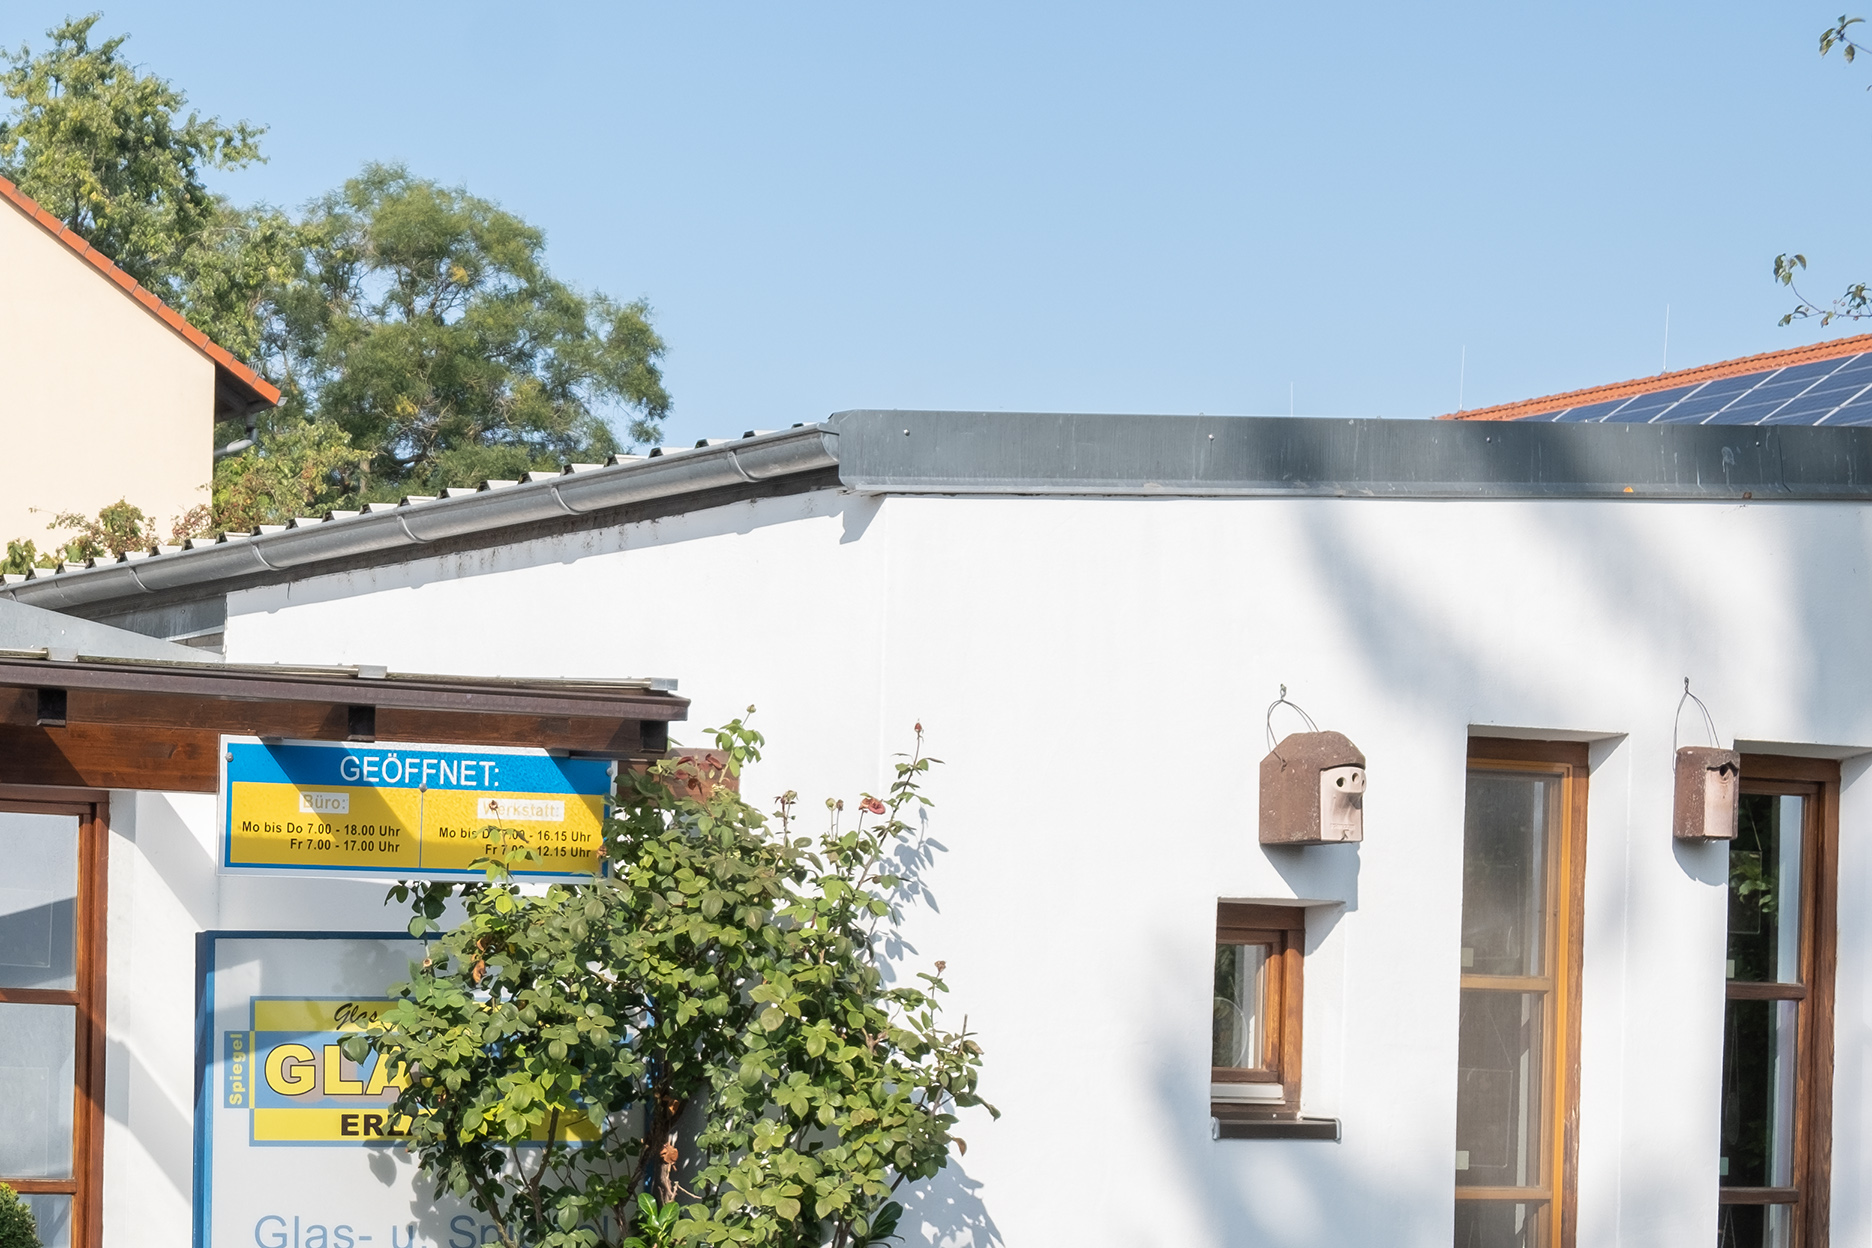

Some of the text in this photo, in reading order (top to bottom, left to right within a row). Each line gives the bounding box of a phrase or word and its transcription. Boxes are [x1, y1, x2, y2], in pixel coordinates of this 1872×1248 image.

[340, 753, 500, 787] GEÖFFNET:
[302, 793, 346, 810] Büro:
[242, 821, 260, 833] Mo
[264, 821, 282, 834] bis
[286, 822, 303, 834] Do
[307, 823, 332, 835] 7.00
[344, 824, 375, 836] 18.00
[379, 825, 401, 837] Uhr
[439, 827, 456, 838] Mo
[537, 830, 567, 842] 16.15
[571, 831, 592, 843] Uhr
[290, 838, 303, 850] Fr
[307, 839, 331, 851] 7.00
[343, 840, 375, 852] 17.00
[378, 840, 400, 853] Uhr
[485, 844, 498, 855] Fr
[537, 845, 567, 857] 12.15
[570, 846, 592, 858] Uhr
[229, 1033, 247, 1106] Spiegel
